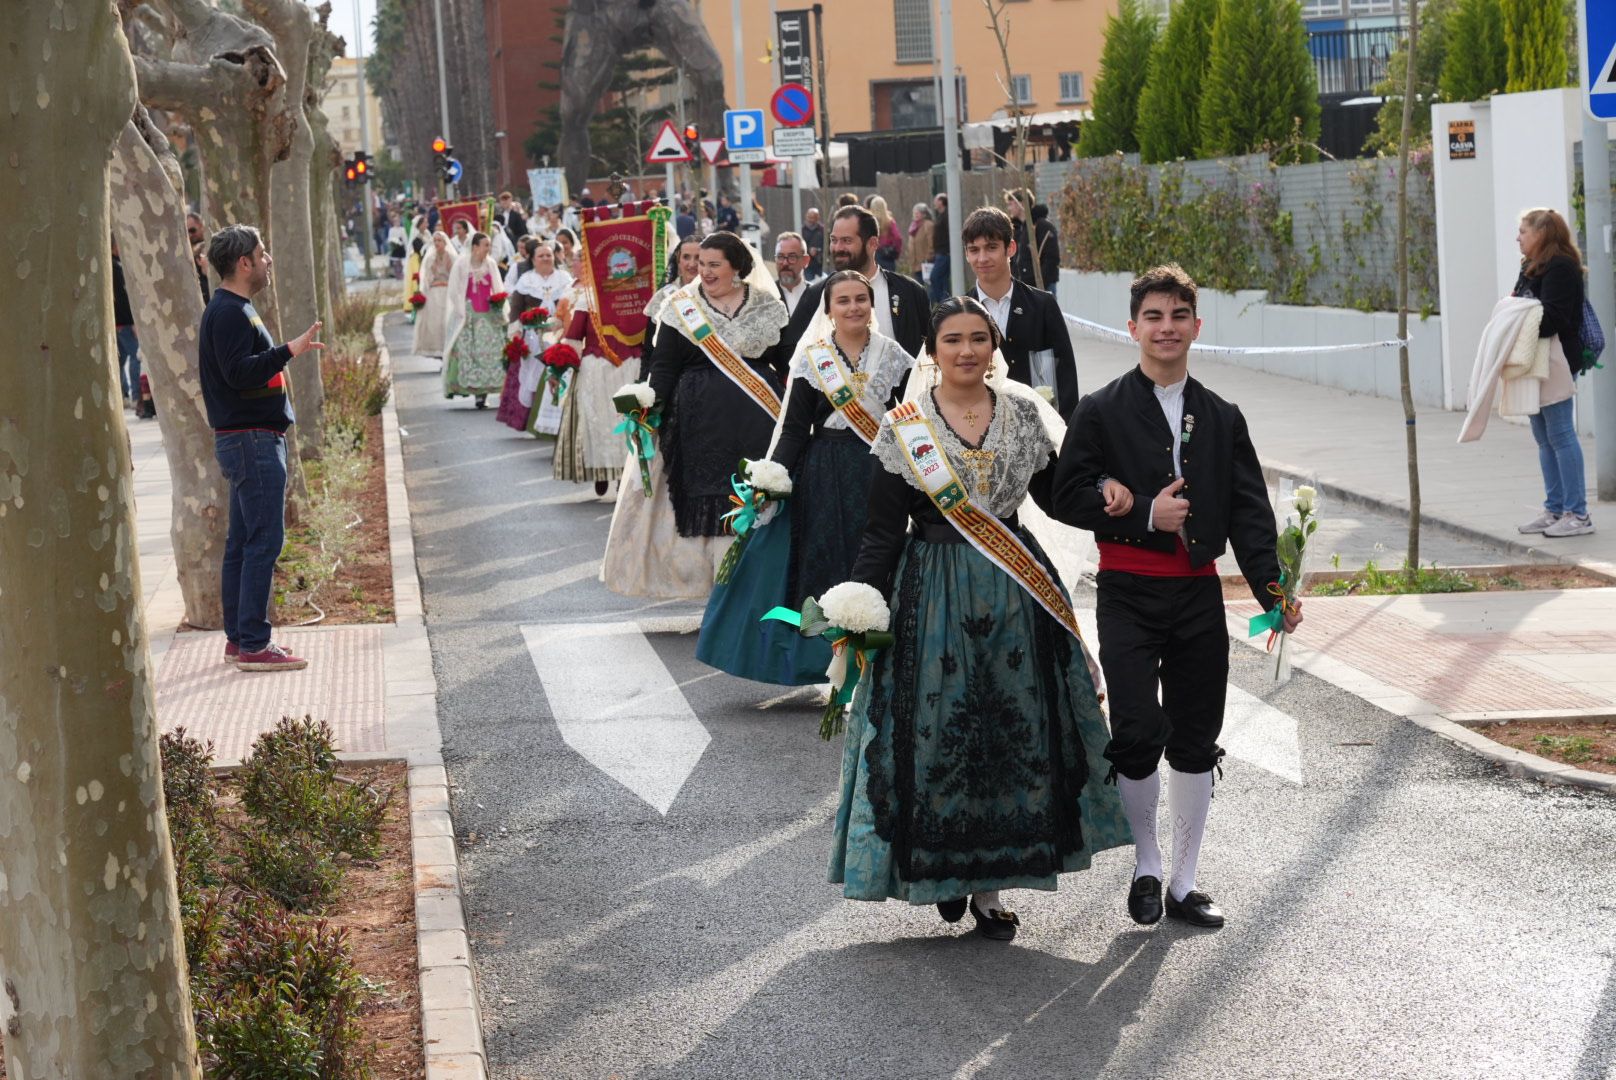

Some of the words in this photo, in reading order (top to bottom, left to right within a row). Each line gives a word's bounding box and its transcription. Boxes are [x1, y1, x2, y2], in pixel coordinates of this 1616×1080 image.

[733, 115, 756, 146] P
[1450, 142, 1474, 150] CASVA
[922, 462, 940, 477] 2023
[970, 521, 1021, 566] DAMA
